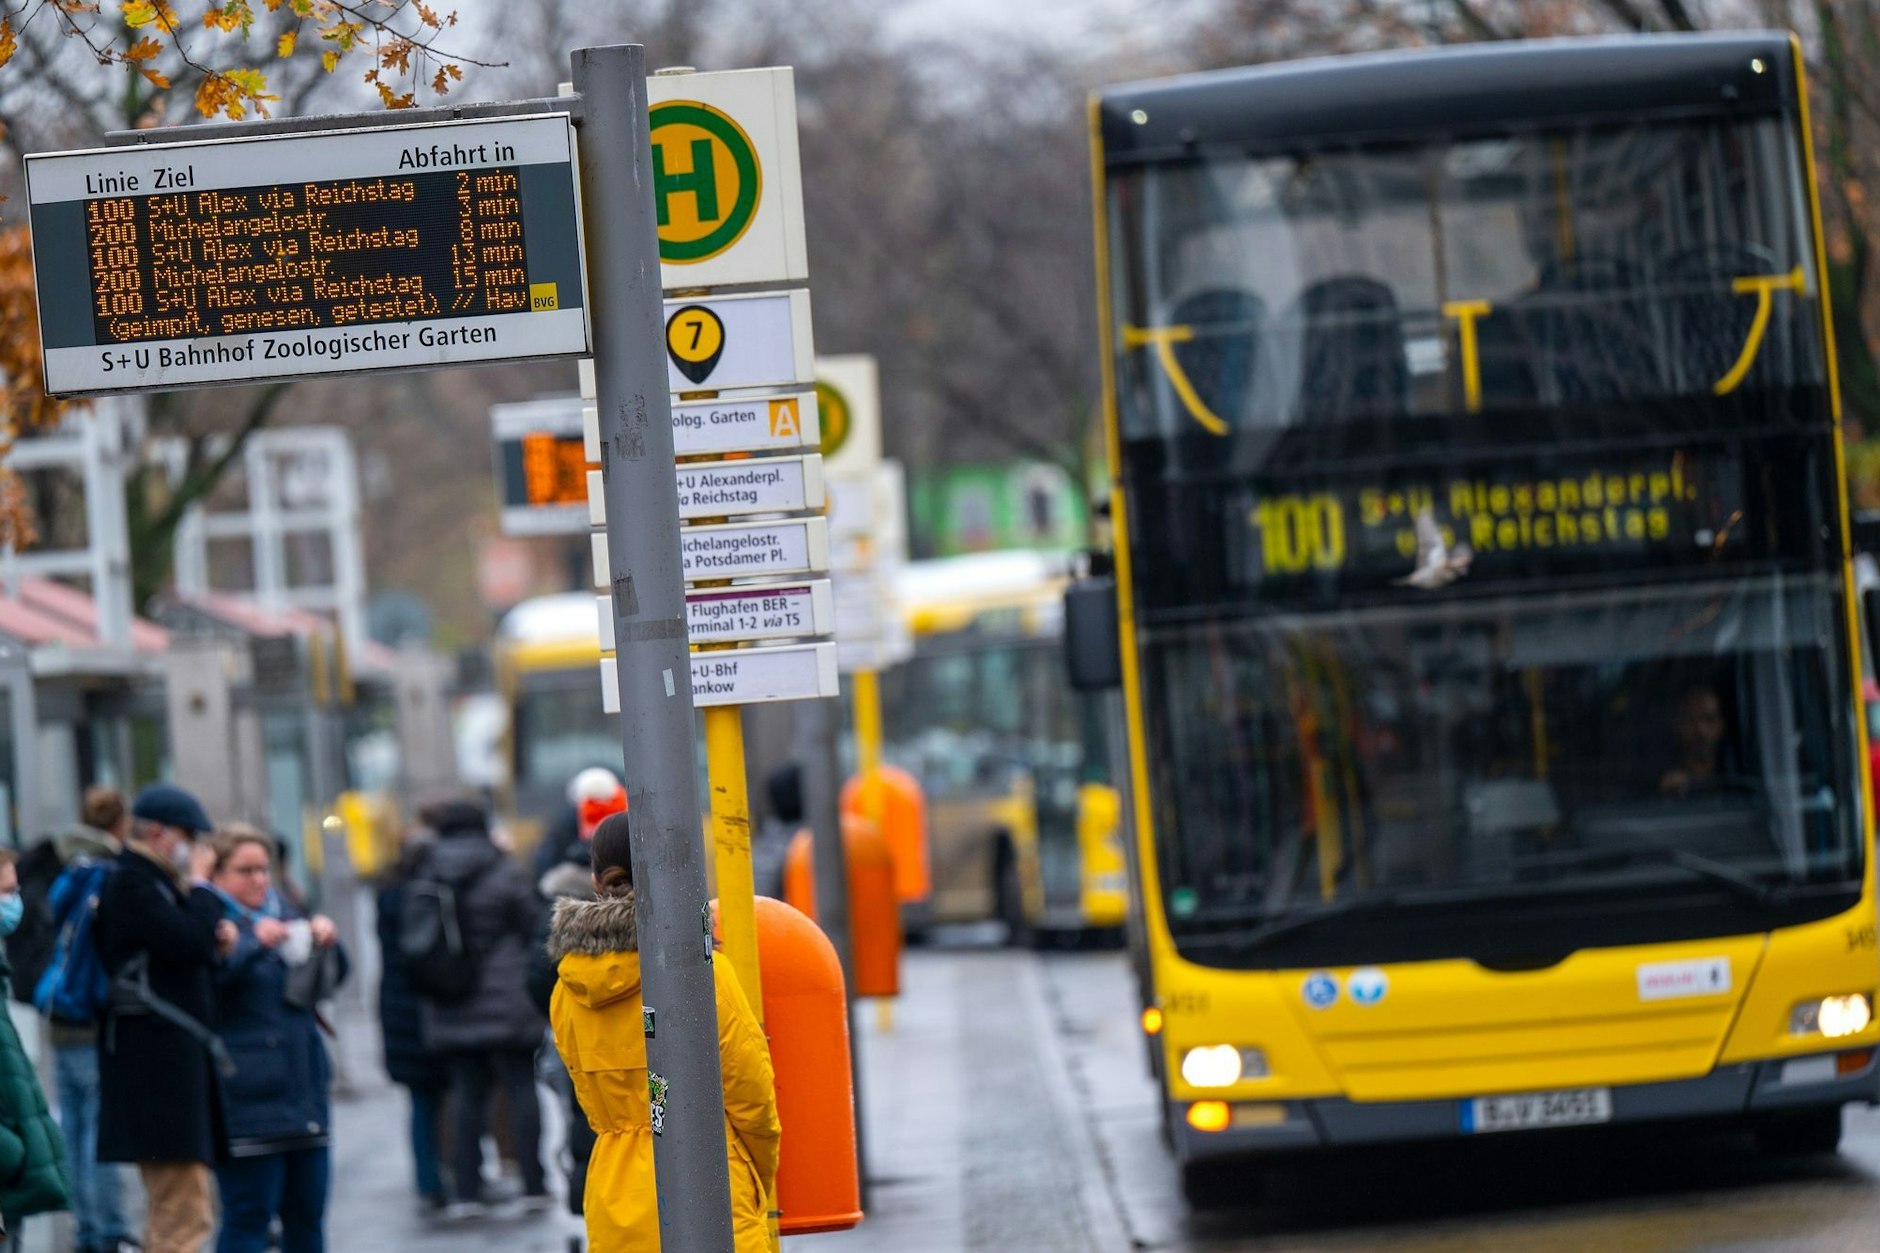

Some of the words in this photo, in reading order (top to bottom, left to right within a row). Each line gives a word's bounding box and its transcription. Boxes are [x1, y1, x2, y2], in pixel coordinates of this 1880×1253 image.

[398, 143, 487, 169] Abfahrt
[494, 141, 515, 162] in
[86, 172, 139, 194] Linie
[153, 165, 195, 189] Ziel
[457, 172, 470, 195] 2
[476, 169, 517, 193] min
[89, 199, 135, 223] 100
[148, 195, 188, 218] S+U
[200, 191, 248, 214] Alex
[258, 187, 295, 209] via
[305, 179, 415, 206] Reichstag
[459, 196, 472, 217] 3
[478, 193, 519, 216] min
[90, 222, 137, 246] 200
[150, 208, 330, 242] Michelangelostr.
[460, 219, 474, 241] 8
[480, 217, 521, 240] min
[92, 246, 139, 270] 100
[152, 241, 192, 265] S+U
[203, 239, 252, 261] Alex
[263, 235, 299, 256] via
[309, 226, 419, 252] Reichstag
[452, 243, 476, 265] 13
[482, 241, 523, 263] min
[94, 269, 141, 293] 200
[154, 255, 334, 288] Michelangelostr.
[453, 266, 478, 289] 15
[484, 264, 525, 287] min
[97, 293, 143, 317] 100
[157, 289, 196, 312] S+U
[207, 286, 257, 308] Alex
[267, 281, 303, 303] via
[313, 273, 422, 300] Reichstag
[534, 296, 555, 309] BVG
[110, 311, 210, 341] (geimpft,
[221, 307, 320, 333] genesen,
[685, 321, 703, 350] 7
[101, 349, 150, 372] S+U
[159, 339, 254, 368] Bahnhof
[263, 330, 411, 360] Zoologischer
[418, 326, 498, 348] Garten
[672, 413, 706, 430] olog.
[710, 410, 756, 426] Garten
[773, 404, 801, 437] A
[677, 475, 695, 489] +U
[700, 469, 784, 489] Alexanderpl.
[1449, 462, 1696, 519] Alexanderpl.
[693, 489, 758, 505] Reichstag
[682, 533, 780, 553] ichelangelostr.
[1250, 492, 1346, 574] 100
[1395, 524, 1456, 558] va
[1469, 505, 1671, 553] Reichstag
[695, 551, 768, 568] Potsdamer
[771, 550, 787, 565] Pl.
[692, 600, 759, 619] Flughafen
[763, 597, 789, 612] BER
[688, 618, 734, 633] rminal
[739, 616, 758, 630] 1-2
[763, 616, 783, 629] via
[691, 661, 738, 678] +U-Bhf
[691, 680, 735, 694] ankow
